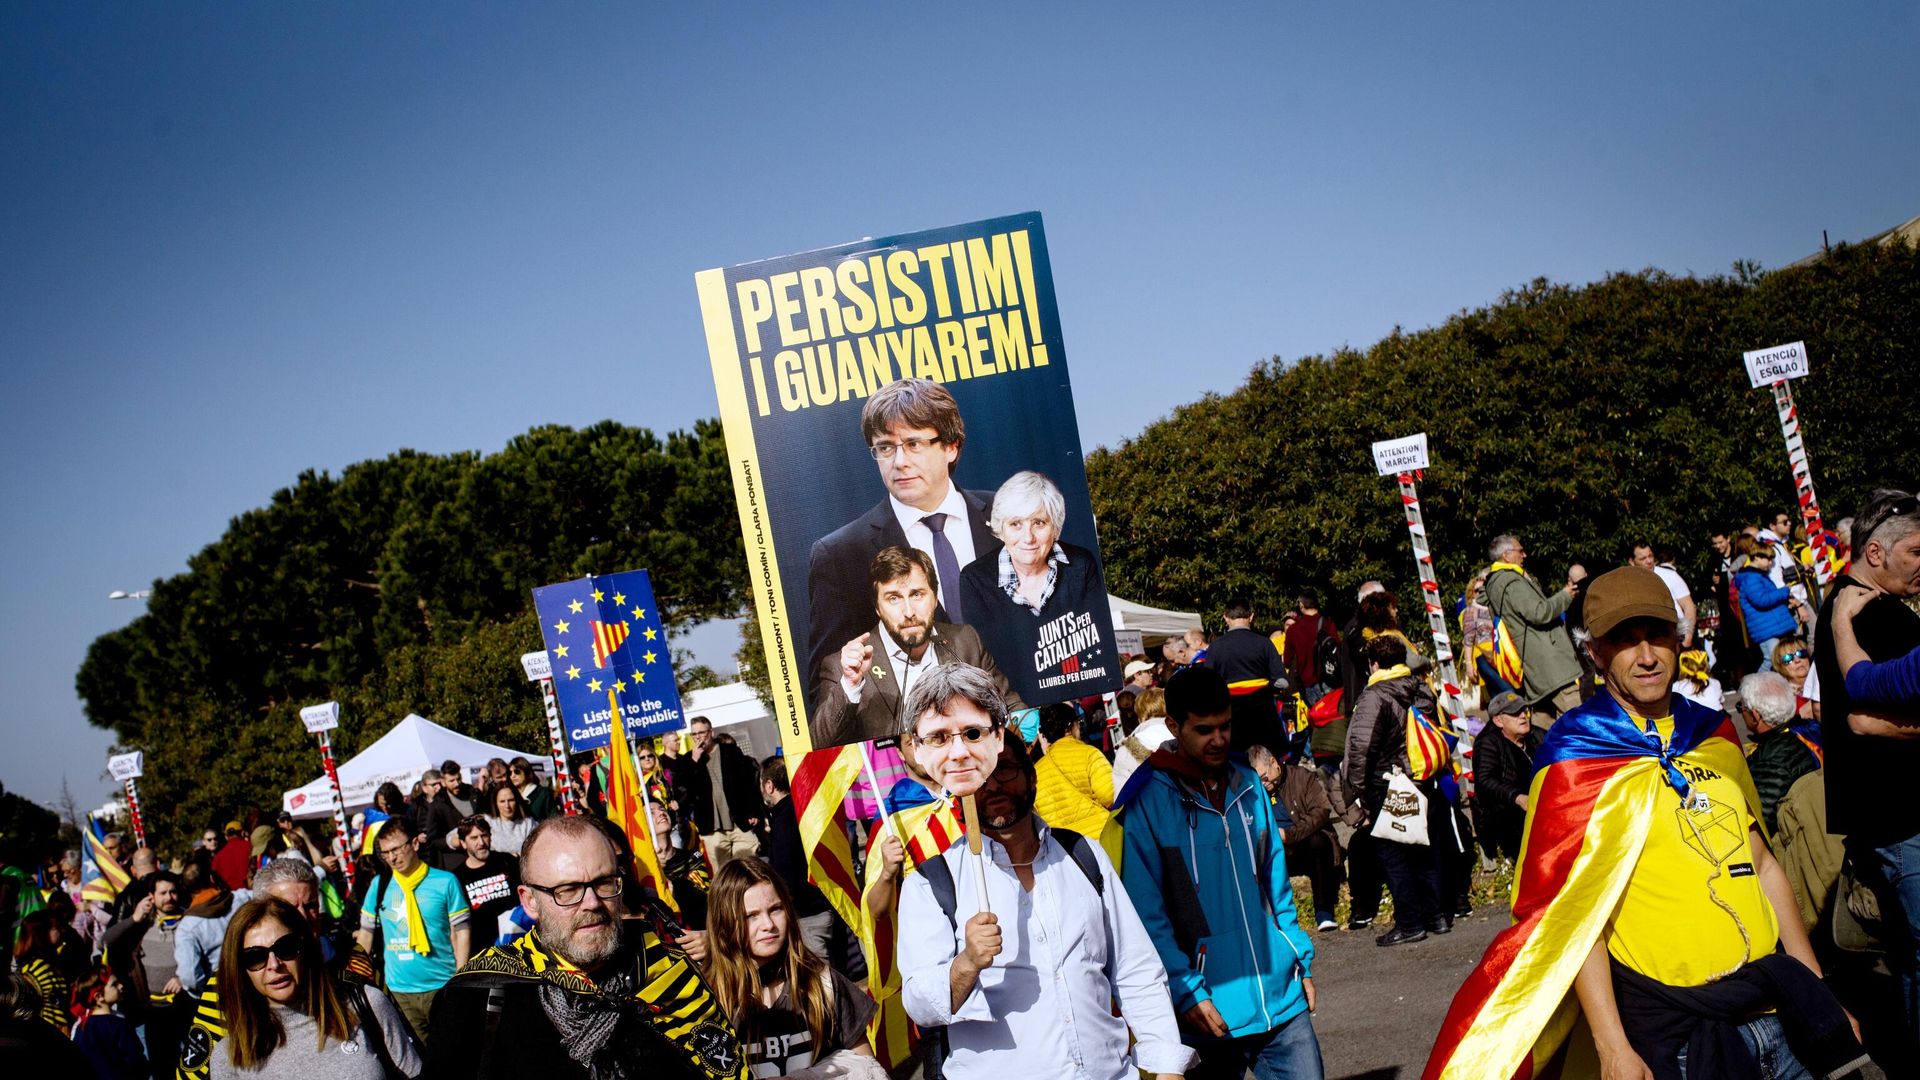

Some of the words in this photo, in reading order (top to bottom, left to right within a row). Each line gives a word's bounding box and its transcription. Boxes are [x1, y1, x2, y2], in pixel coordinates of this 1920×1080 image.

[1755, 346, 1797, 366] ATENCIÓ
[749, 356, 771, 416] I
[1379, 444, 1419, 458] ATTENTION
[1385, 455, 1417, 468] MARCHE
[741, 460, 757, 506] PONSATÍ
[752, 507, 764, 545] CLARA
[760, 551, 772, 587] COMÍN
[767, 589, 777, 615] TONI
[1037, 611, 1076, 649] JUNTS
[1076, 611, 1092, 630] PER
[772, 622, 793, 693] PUIGDEMONT
[1034, 623, 1100, 672] CATALUNYA
[1038, 674, 1066, 689] LLIURES
[1066, 672, 1080, 683] PER
[1080, 666, 1106, 680] EUROPA
[626, 704, 640, 715] to
[641, 699, 663, 712] the
[626, 709, 679, 728] Republic
[786, 694, 800, 736] CARLES
[467, 880, 509, 900] PRESOS
